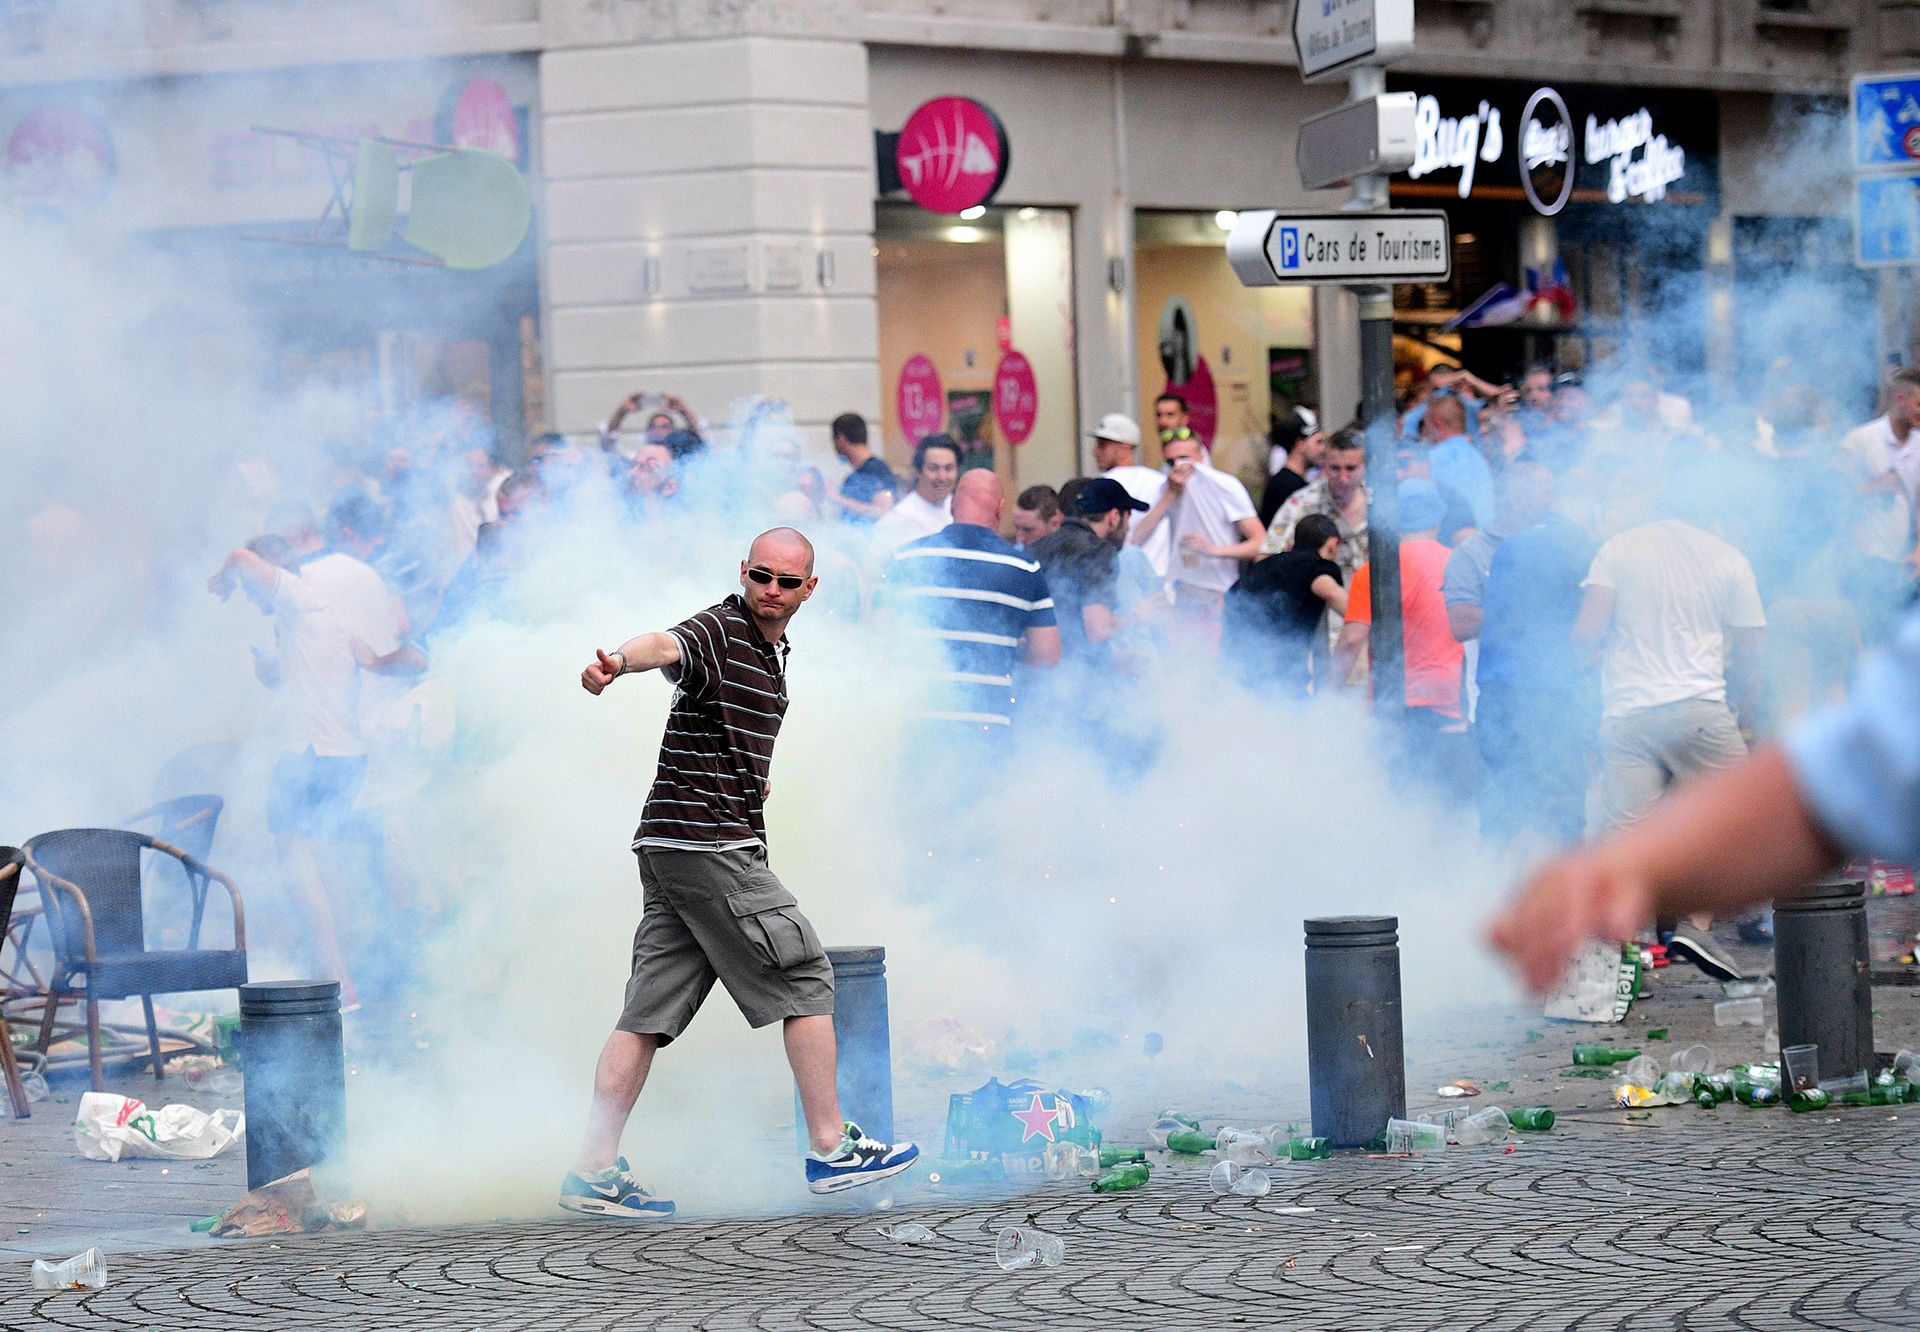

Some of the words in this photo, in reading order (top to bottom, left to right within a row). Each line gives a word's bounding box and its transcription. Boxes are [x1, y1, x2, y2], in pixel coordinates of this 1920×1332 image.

[1408, 94, 1503, 199] Bug's
[1282, 230, 1297, 267] P
[1305, 233, 1340, 261] Cars
[1350, 232, 1367, 262] de
[1377, 231, 1441, 261] Tourisme
